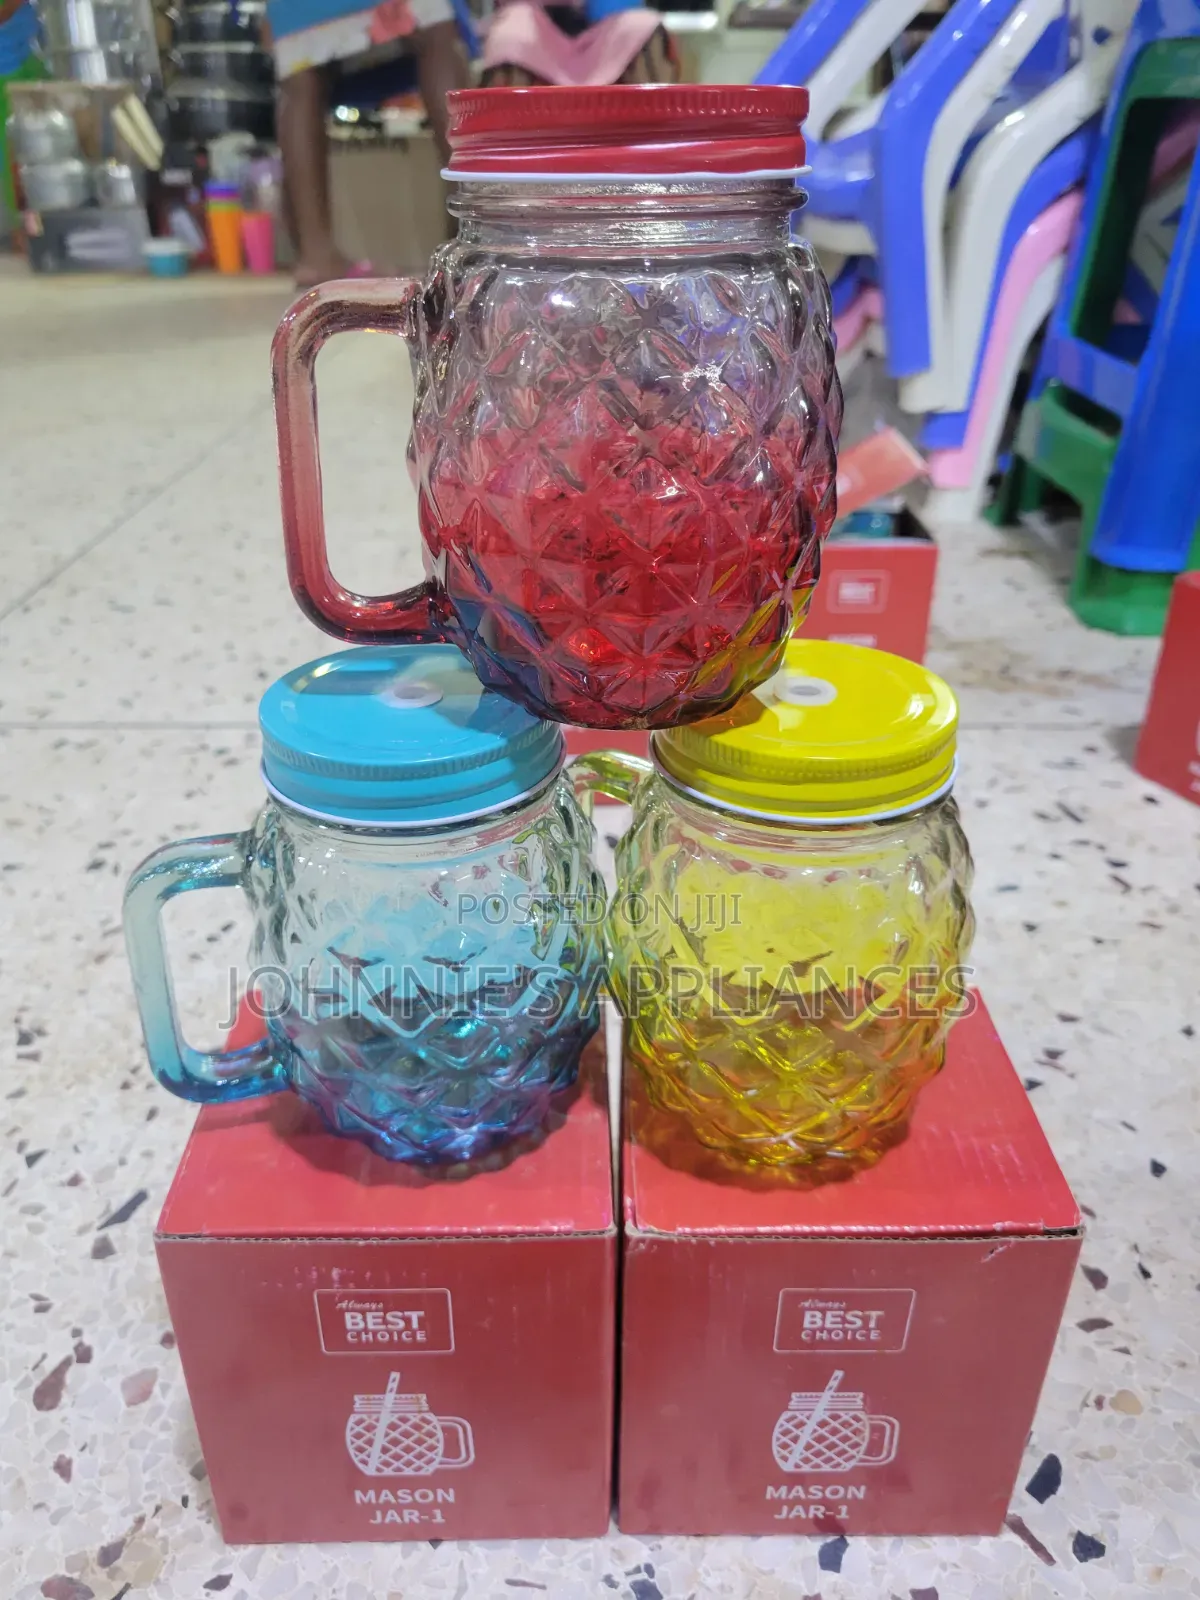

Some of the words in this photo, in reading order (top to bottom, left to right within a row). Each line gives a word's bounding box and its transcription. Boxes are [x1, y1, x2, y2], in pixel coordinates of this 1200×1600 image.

[336, 1299, 383, 1310] Always
[344, 1311, 425, 1331] BEST
[803, 1310, 885, 1329] BEST
[347, 1331, 427, 1343] CHOICE
[801, 1329, 881, 1341] CHOICE
[354, 1488, 455, 1505] MASON
[765, 1485, 866, 1501] MASON
[369, 1509, 446, 1525] JAR-1
[774, 1505, 849, 1520] JAR-1
